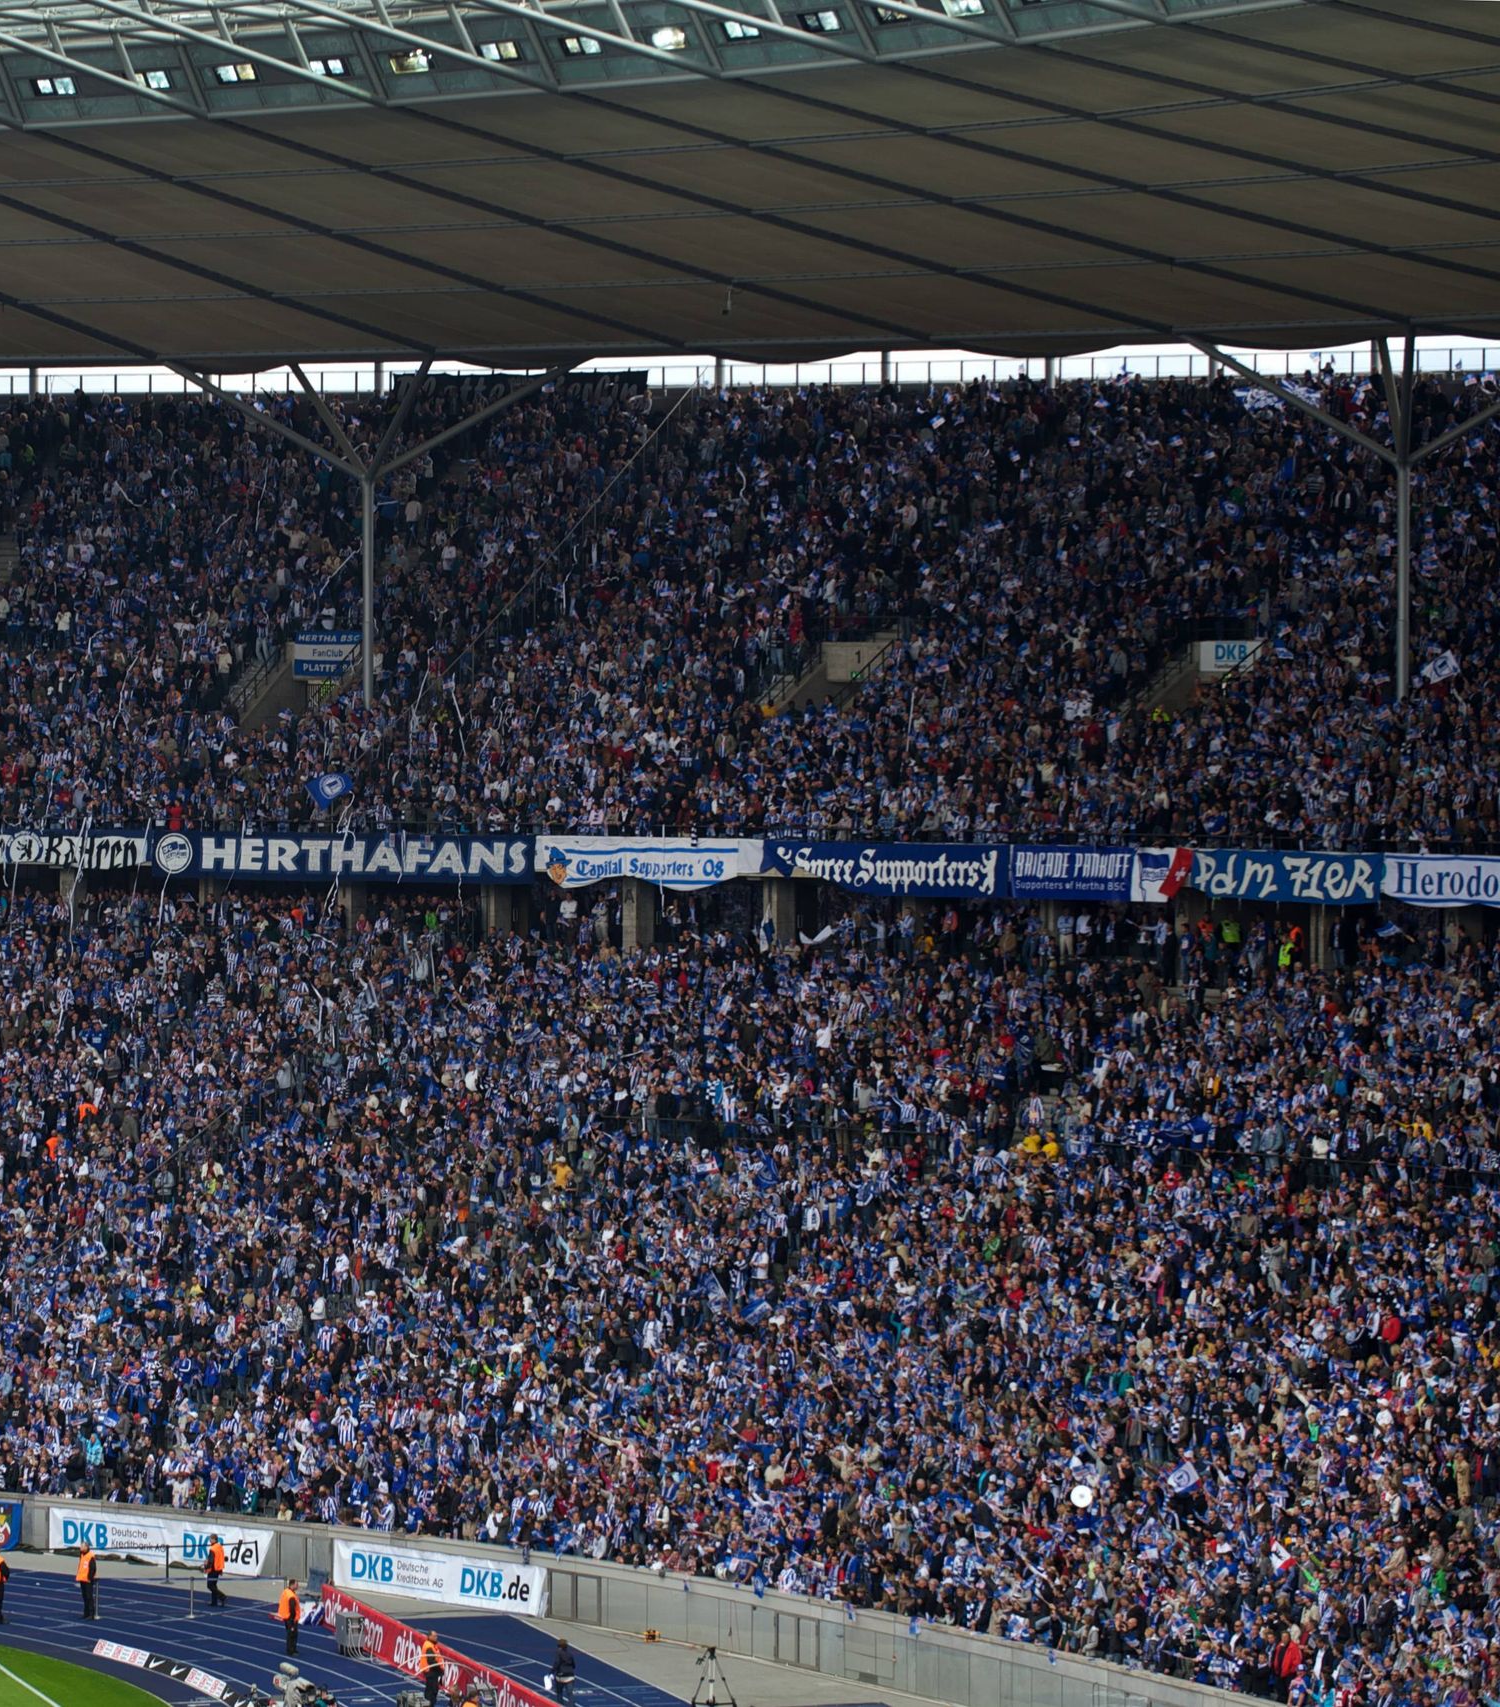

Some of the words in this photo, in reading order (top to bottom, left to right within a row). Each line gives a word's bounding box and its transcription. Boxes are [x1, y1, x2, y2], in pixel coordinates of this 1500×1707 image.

[298, 633, 337, 643] HERTHA
[340, 634, 361, 643] BSC
[312, 648, 344, 658] FanClub
[1214, 644, 1248, 661] DKB
[200, 836, 528, 876] HERTHAFANS
[1015, 851, 1069, 879] BRIGADE
[576, 858, 622, 878] Capital
[854, 848, 979, 893] Supporters
[1015, 880, 1063, 890] Supporters
[1075, 881, 1105, 890] Hertha
[1107, 881, 1127, 891] BSC
[63, 1519, 108, 1550] DKB
[111, 1526, 148, 1539] Deutsche
[111, 1539, 153, 1551] Kreditbank
[183, 1531, 253, 1566] DK.de
[351, 1552, 393, 1583] DKB
[397, 1561, 429, 1574] Deutsche
[397, 1574, 431, 1588] Kreditbank
[431, 1578, 444, 1589] AG
[460, 1567, 530, 1603] DKB.de
